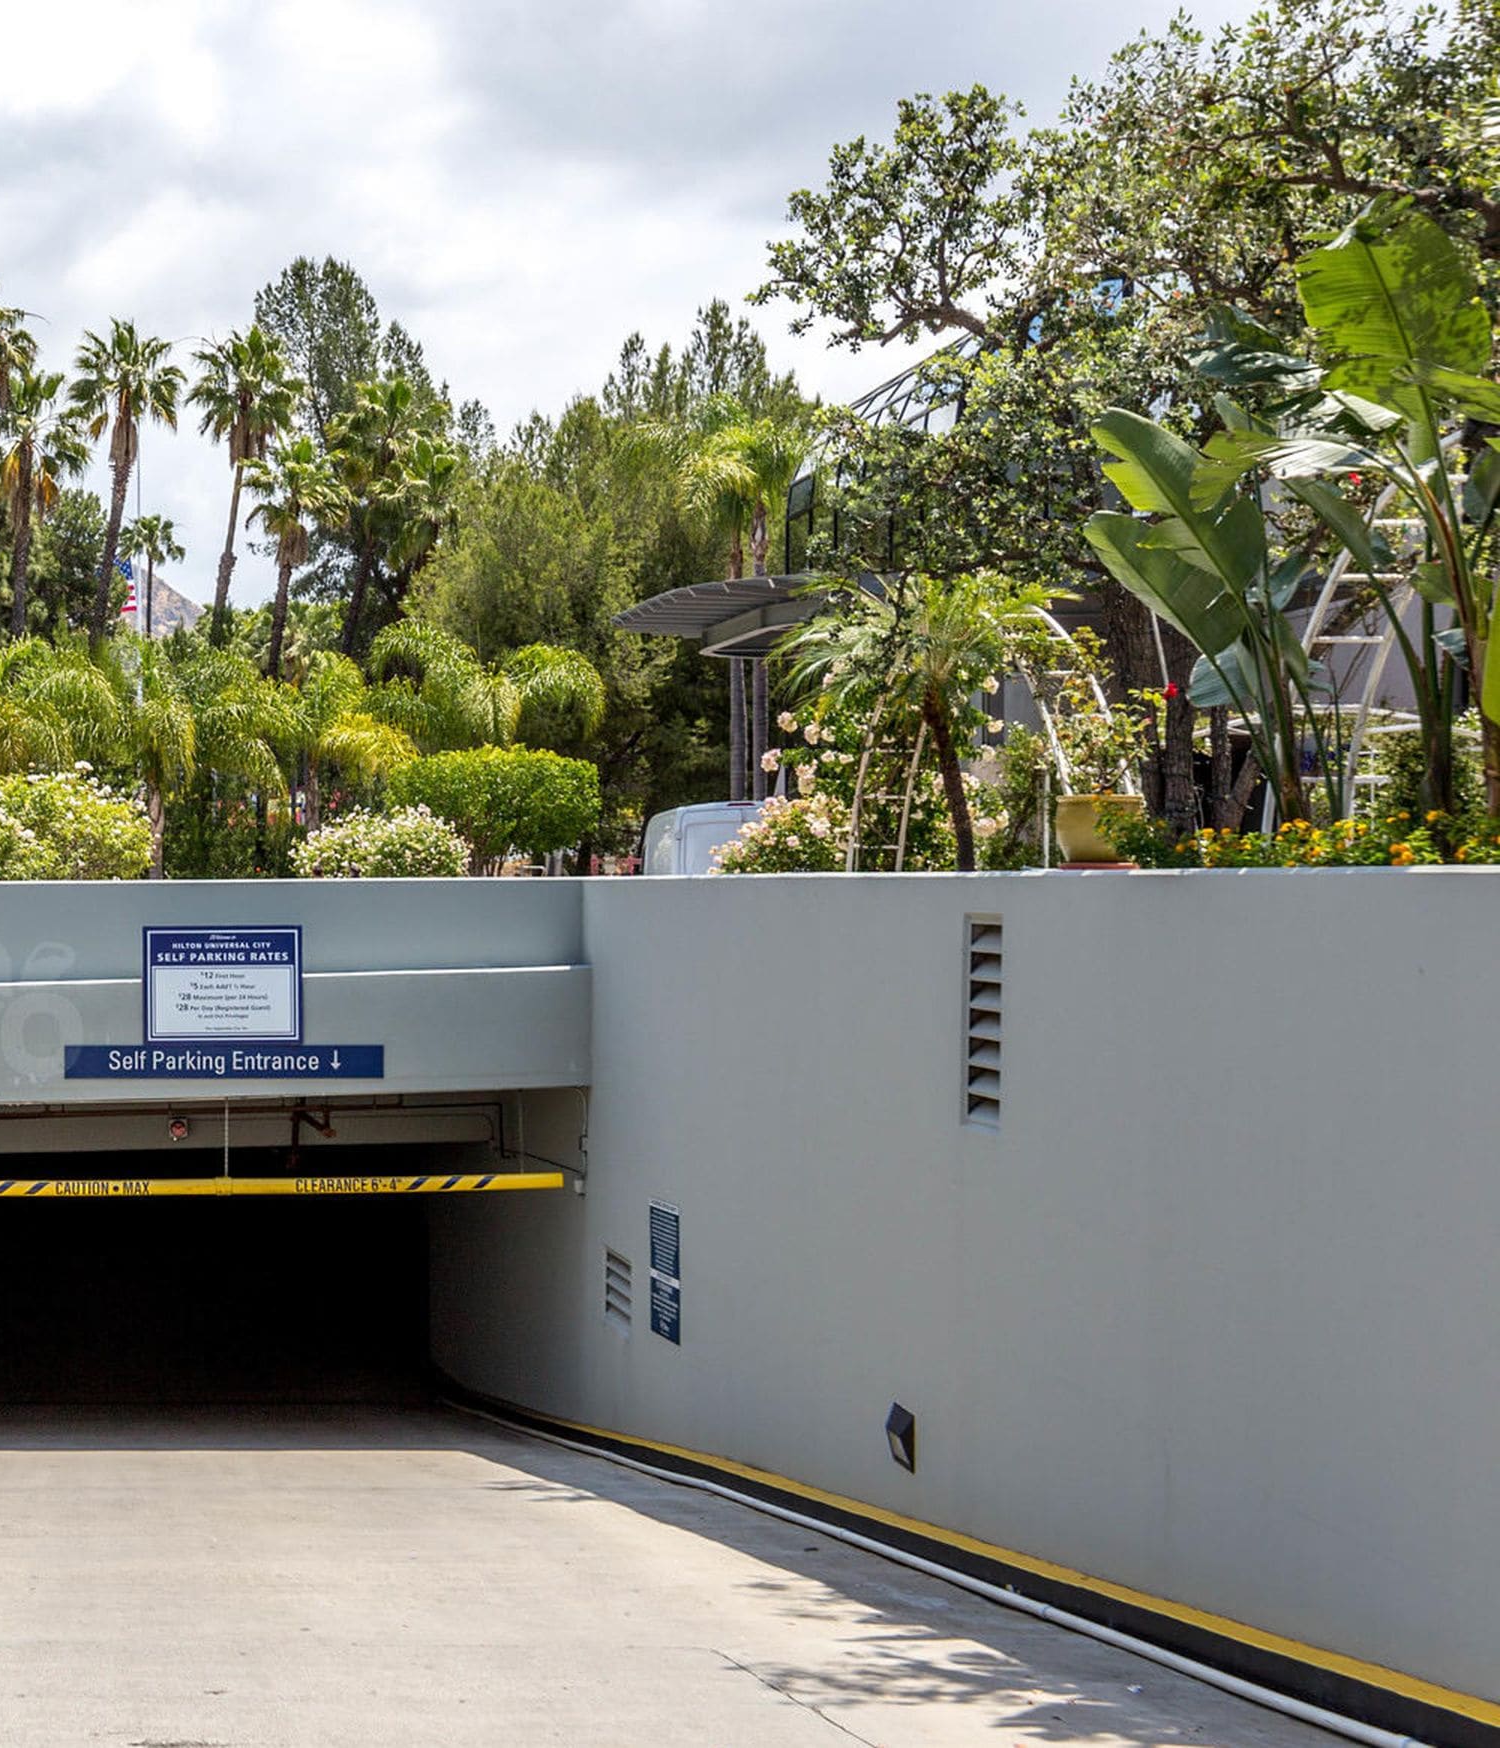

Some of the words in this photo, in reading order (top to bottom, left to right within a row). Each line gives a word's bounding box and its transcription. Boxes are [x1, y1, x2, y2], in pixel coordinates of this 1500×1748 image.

[157, 952, 186, 962] SELF
[190, 952, 246, 962] PARKING
[250, 952, 289, 961] RATES
[108, 1050, 147, 1071] Self
[152, 1050, 226, 1075] Parking
[232, 1050, 320, 1071] Entrance
[55, 1181, 109, 1196] CAUTION
[123, 1180, 150, 1196] MAX
[295, 1178, 367, 1193] CLEARANCE
